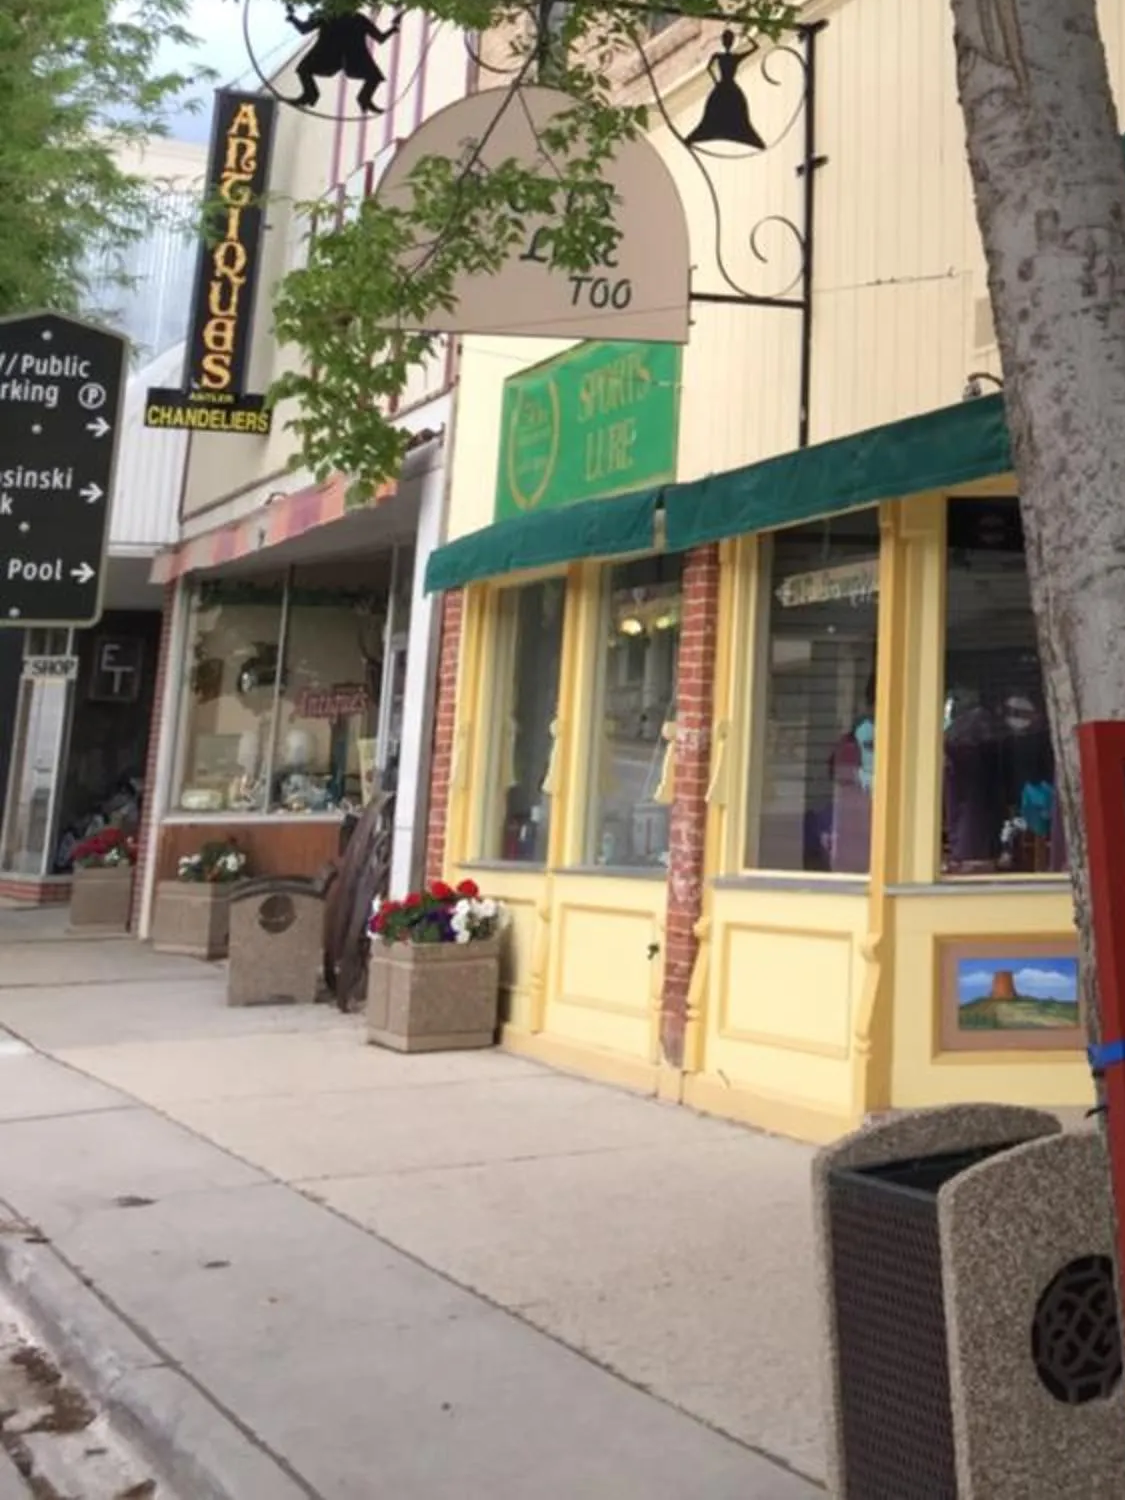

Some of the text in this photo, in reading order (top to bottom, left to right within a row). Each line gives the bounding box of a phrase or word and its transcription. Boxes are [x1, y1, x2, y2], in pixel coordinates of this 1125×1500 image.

[202, 102, 260, 390] ANTIQUES
[567, 274, 632, 310] TOO
[147, 404, 269, 432] CHANDELIERS
[7, 558, 63, 581] Pool
[31, 659, 76, 676] SHOP
